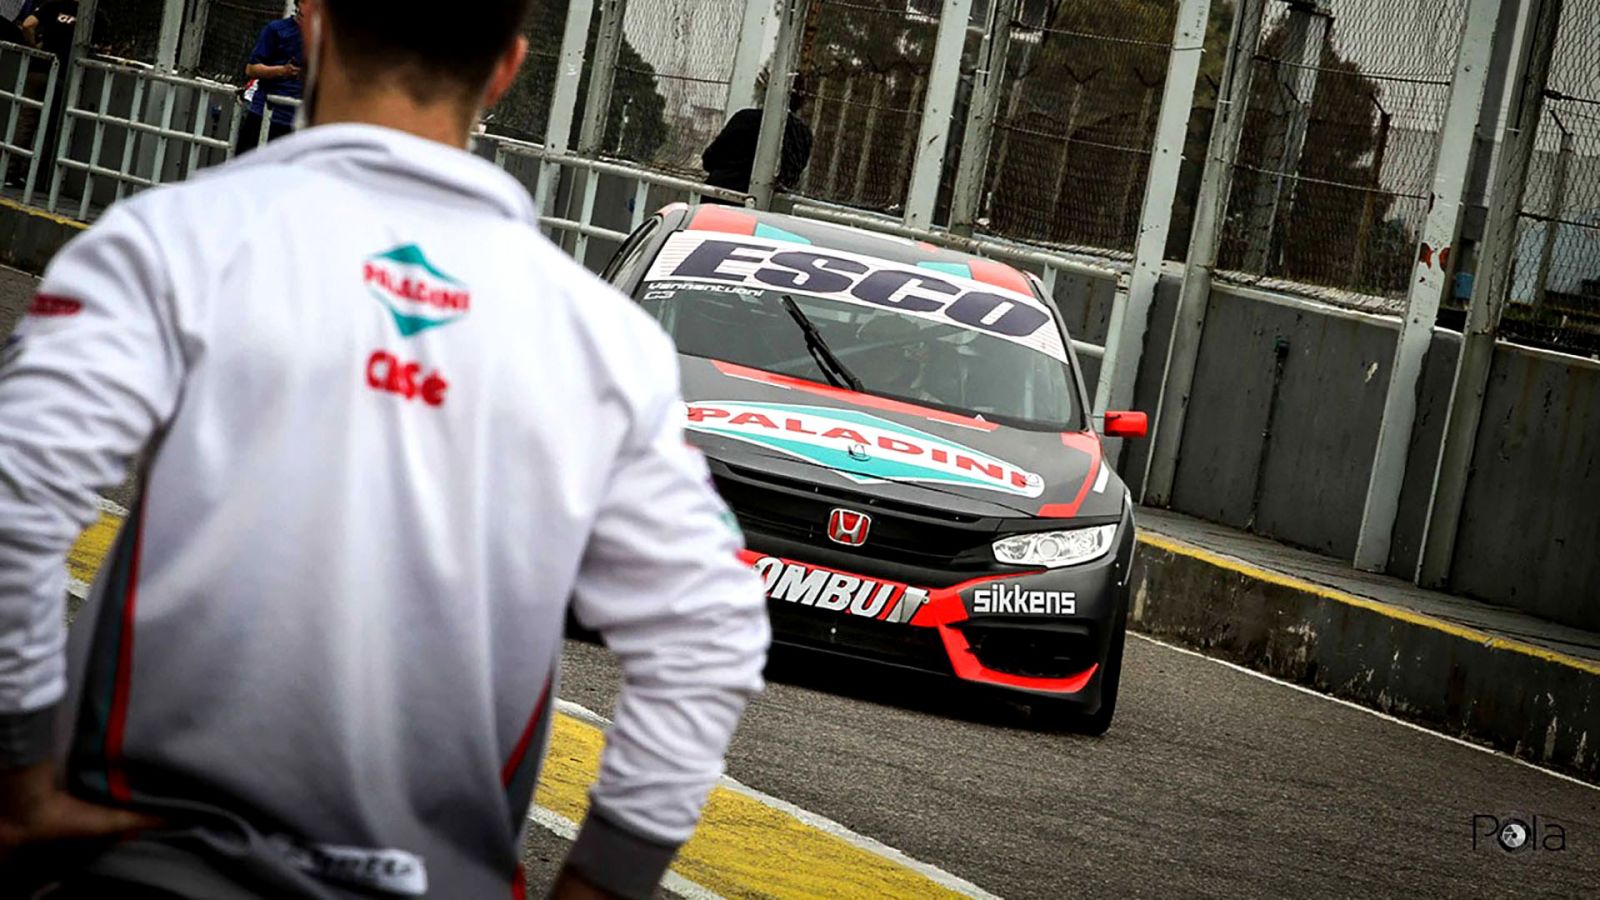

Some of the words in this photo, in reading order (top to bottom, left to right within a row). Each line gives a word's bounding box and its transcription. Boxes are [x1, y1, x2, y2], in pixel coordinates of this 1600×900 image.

[670, 239, 1050, 337] ESCO
[687, 407, 1027, 488] PALADINI
[973, 583, 1076, 614] sikkens
